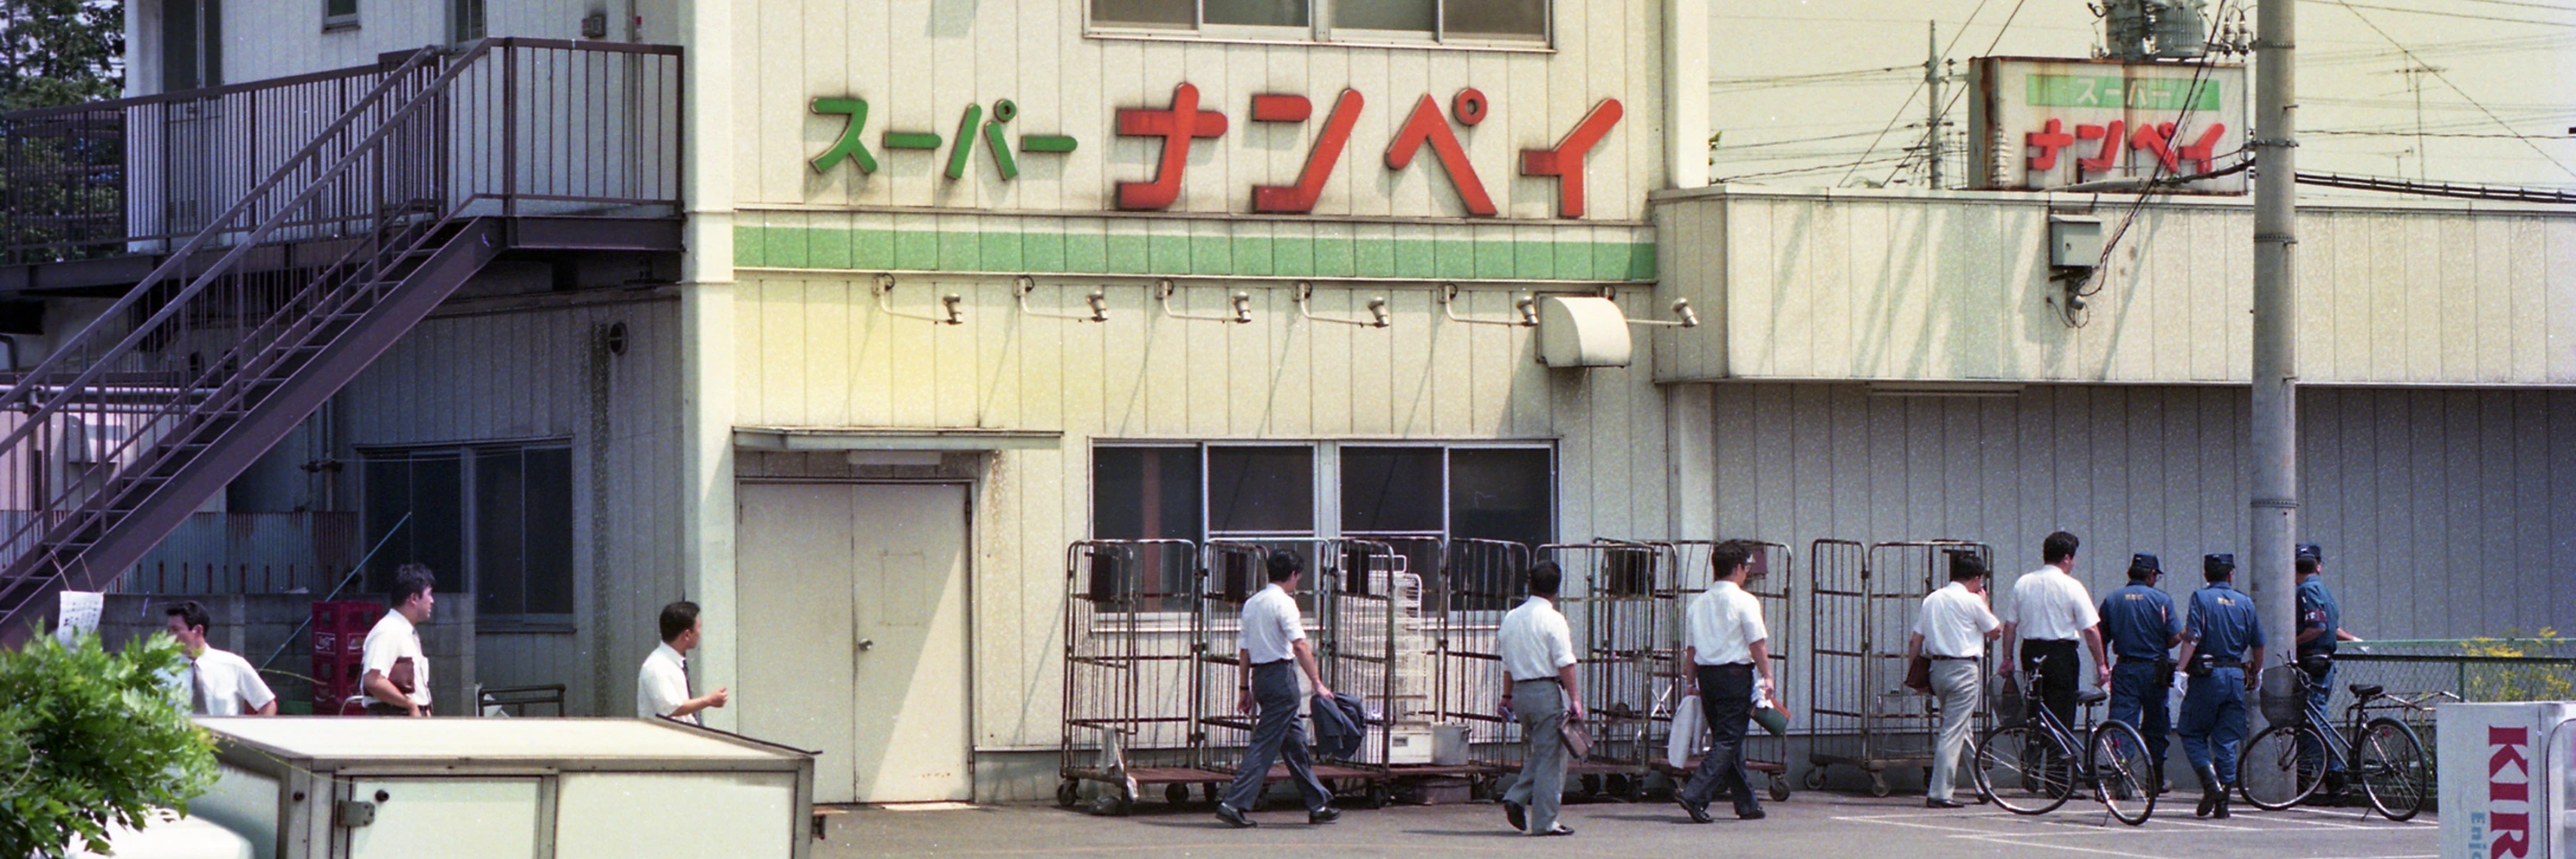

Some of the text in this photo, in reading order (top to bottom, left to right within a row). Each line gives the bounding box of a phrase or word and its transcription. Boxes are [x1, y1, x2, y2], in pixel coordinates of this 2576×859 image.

[809, 81, 1624, 218] スーパー ナンペイ
[2026, 117, 2225, 175] ナンペイ
[2488, 725, 2529, 859] KIR
